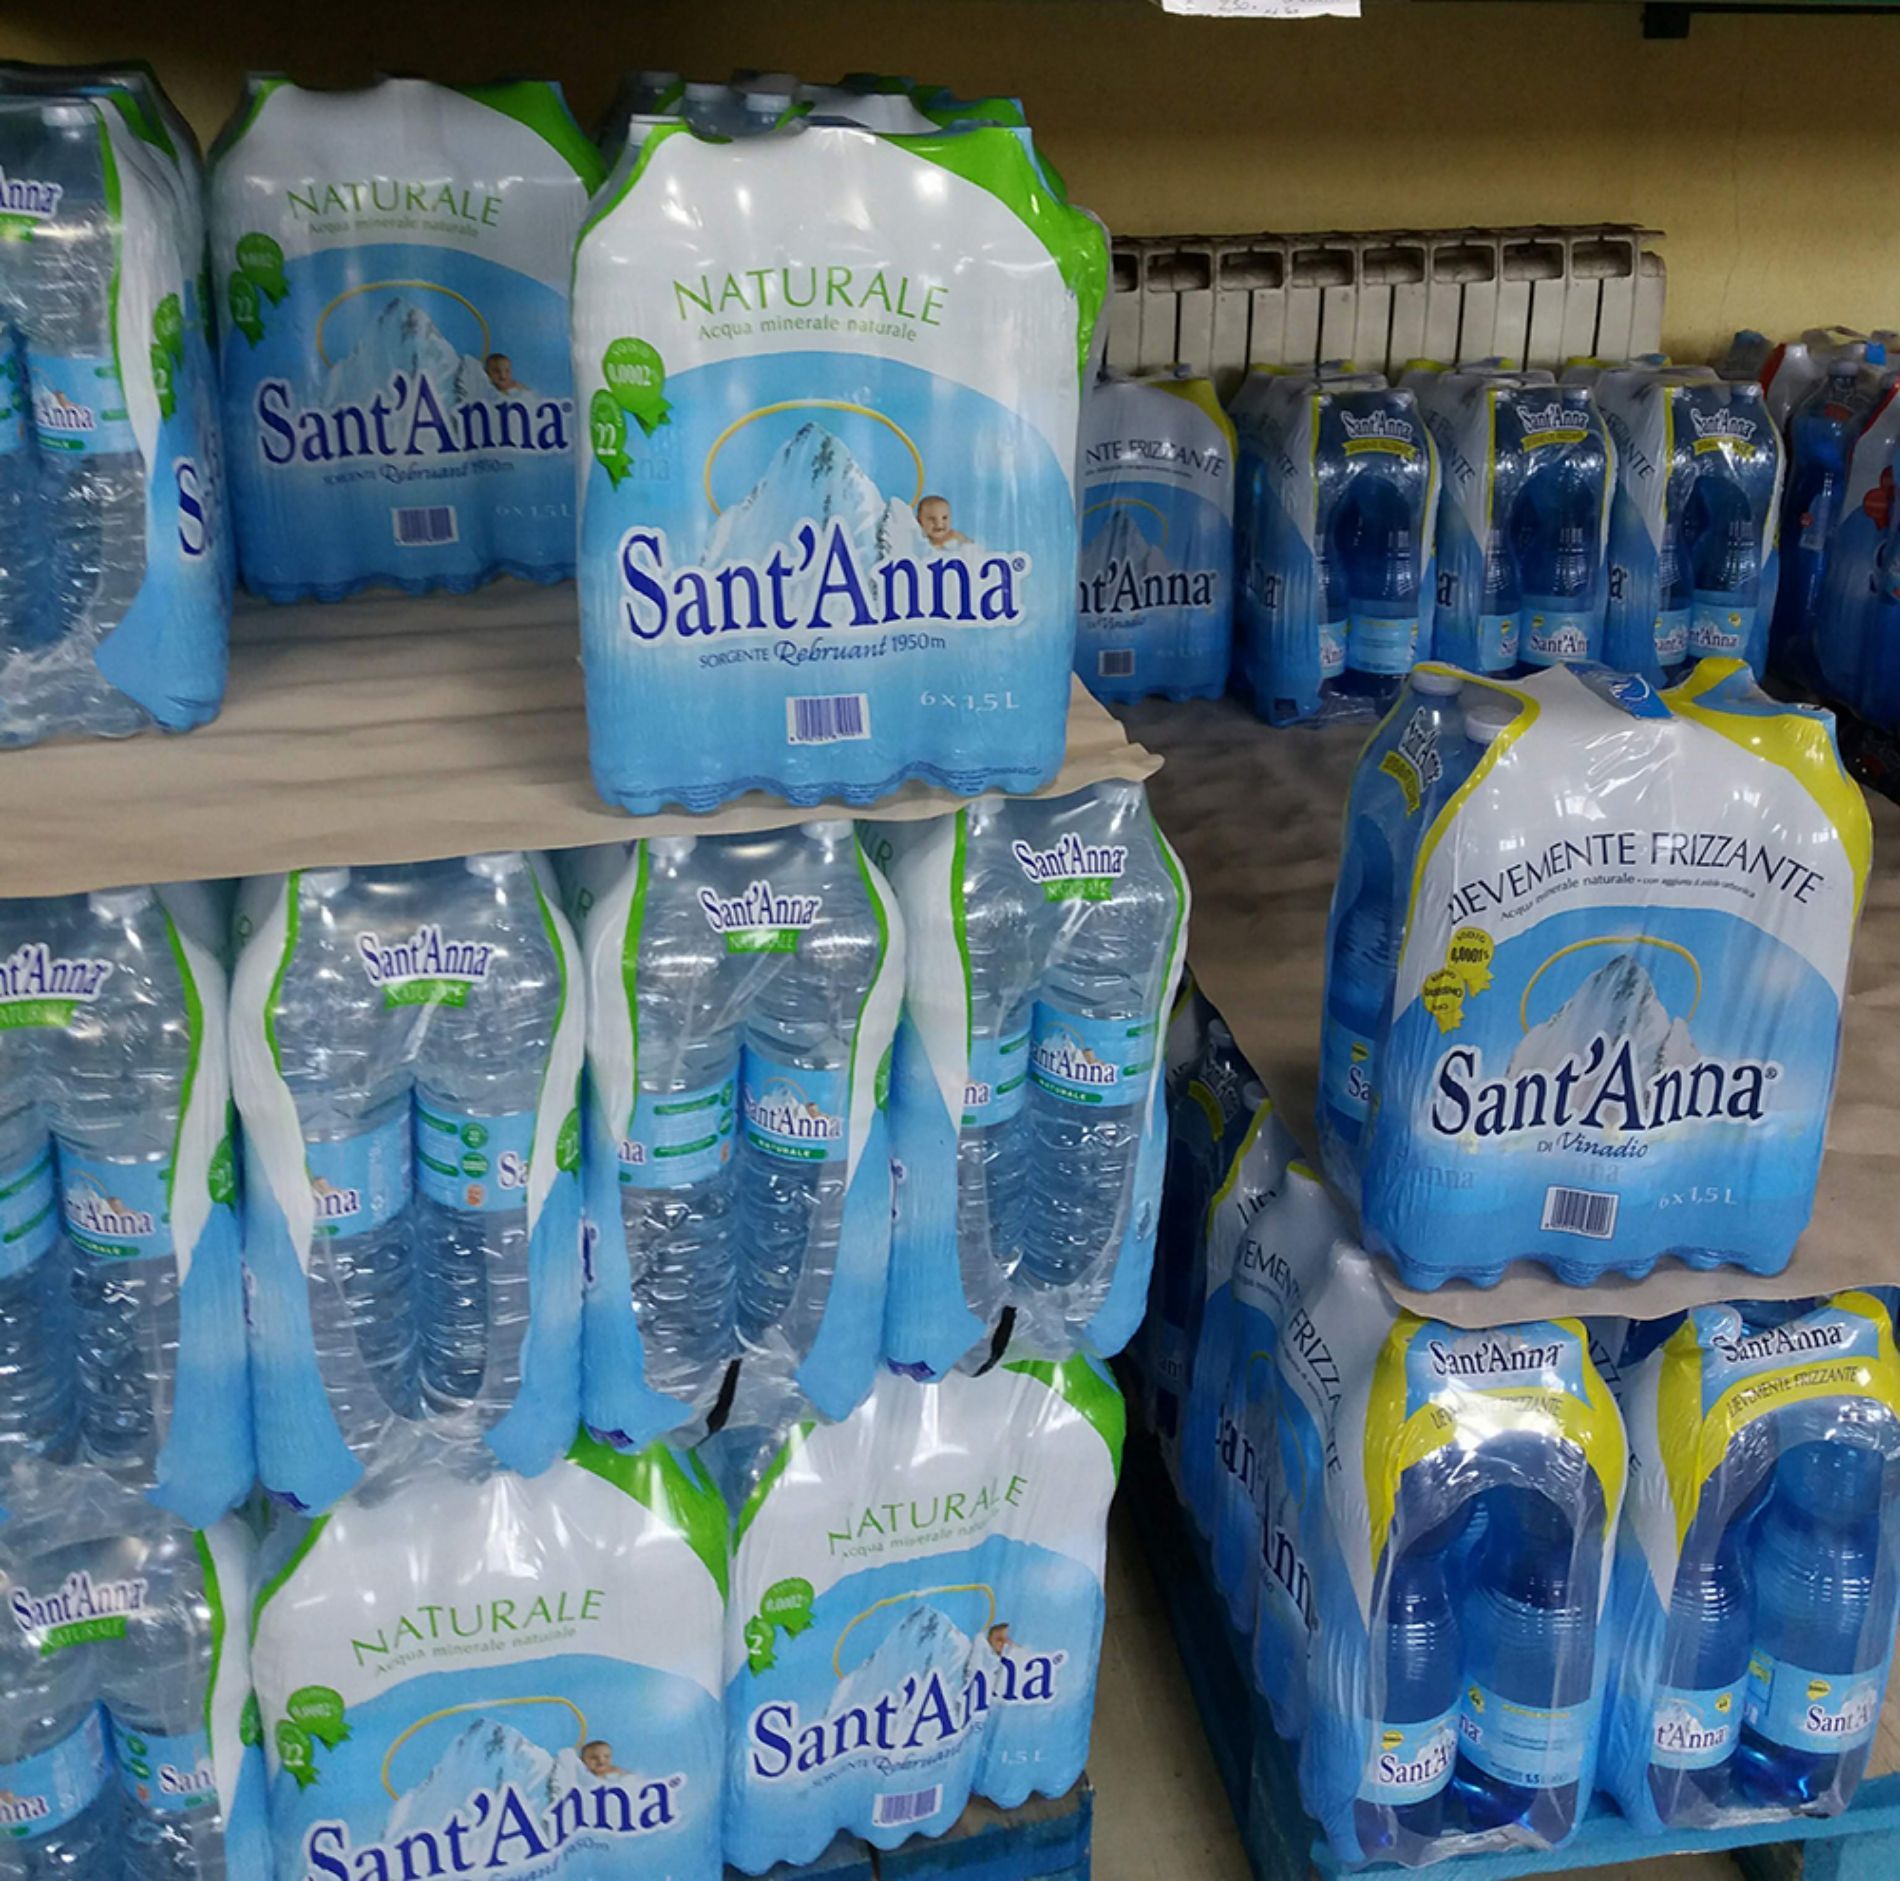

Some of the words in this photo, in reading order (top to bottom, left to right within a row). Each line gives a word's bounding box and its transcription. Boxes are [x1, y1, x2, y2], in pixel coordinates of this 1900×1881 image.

[286, 180, 503, 227] NATURALE
[673, 266, 949, 326] NATURALE
[699, 321, 752, 342] Acqua
[760, 314, 840, 332] minerale
[846, 319, 918, 342] naturale
[257, 374, 569, 465] Sant'Anna
[622, 521, 1020, 640] Sant'Anna
[700, 648, 769, 669] SORGENTE
[773, 636, 887, 667] Rebruant
[891, 632, 947, 653] 1950m
[920, 691, 936, 707] 6
[1005, 690, 1020, 709] L
[1015, 836, 1122, 880] Sant'Anna
[1449, 832, 1637, 925] LIEVEMENTE
[1651, 832, 1825, 904] FRIZZANTE
[1583, 872, 1635, 887] naturale
[701, 884, 817, 930] Sant'Anna
[360, 929, 491, 981] Sant'Anna
[1432, 1036, 1766, 1137] Sant'Anna
[1555, 1131, 1649, 1159] Vinadio
[1430, 1341, 1561, 1376] Sant'Anna
[1711, 1324, 1845, 1363] Sant'Anna
[1794, 1366, 1859, 1388] FRIZZANTE
[828, 1474, 1028, 1556] NATURALE
[10, 1573, 143, 1631] Sant'Anna
[351, 1588, 607, 1667] NATURALE
[432, 1638, 506, 1657] minerale
[305, 1782, 675, 1881] Sant'Anna
